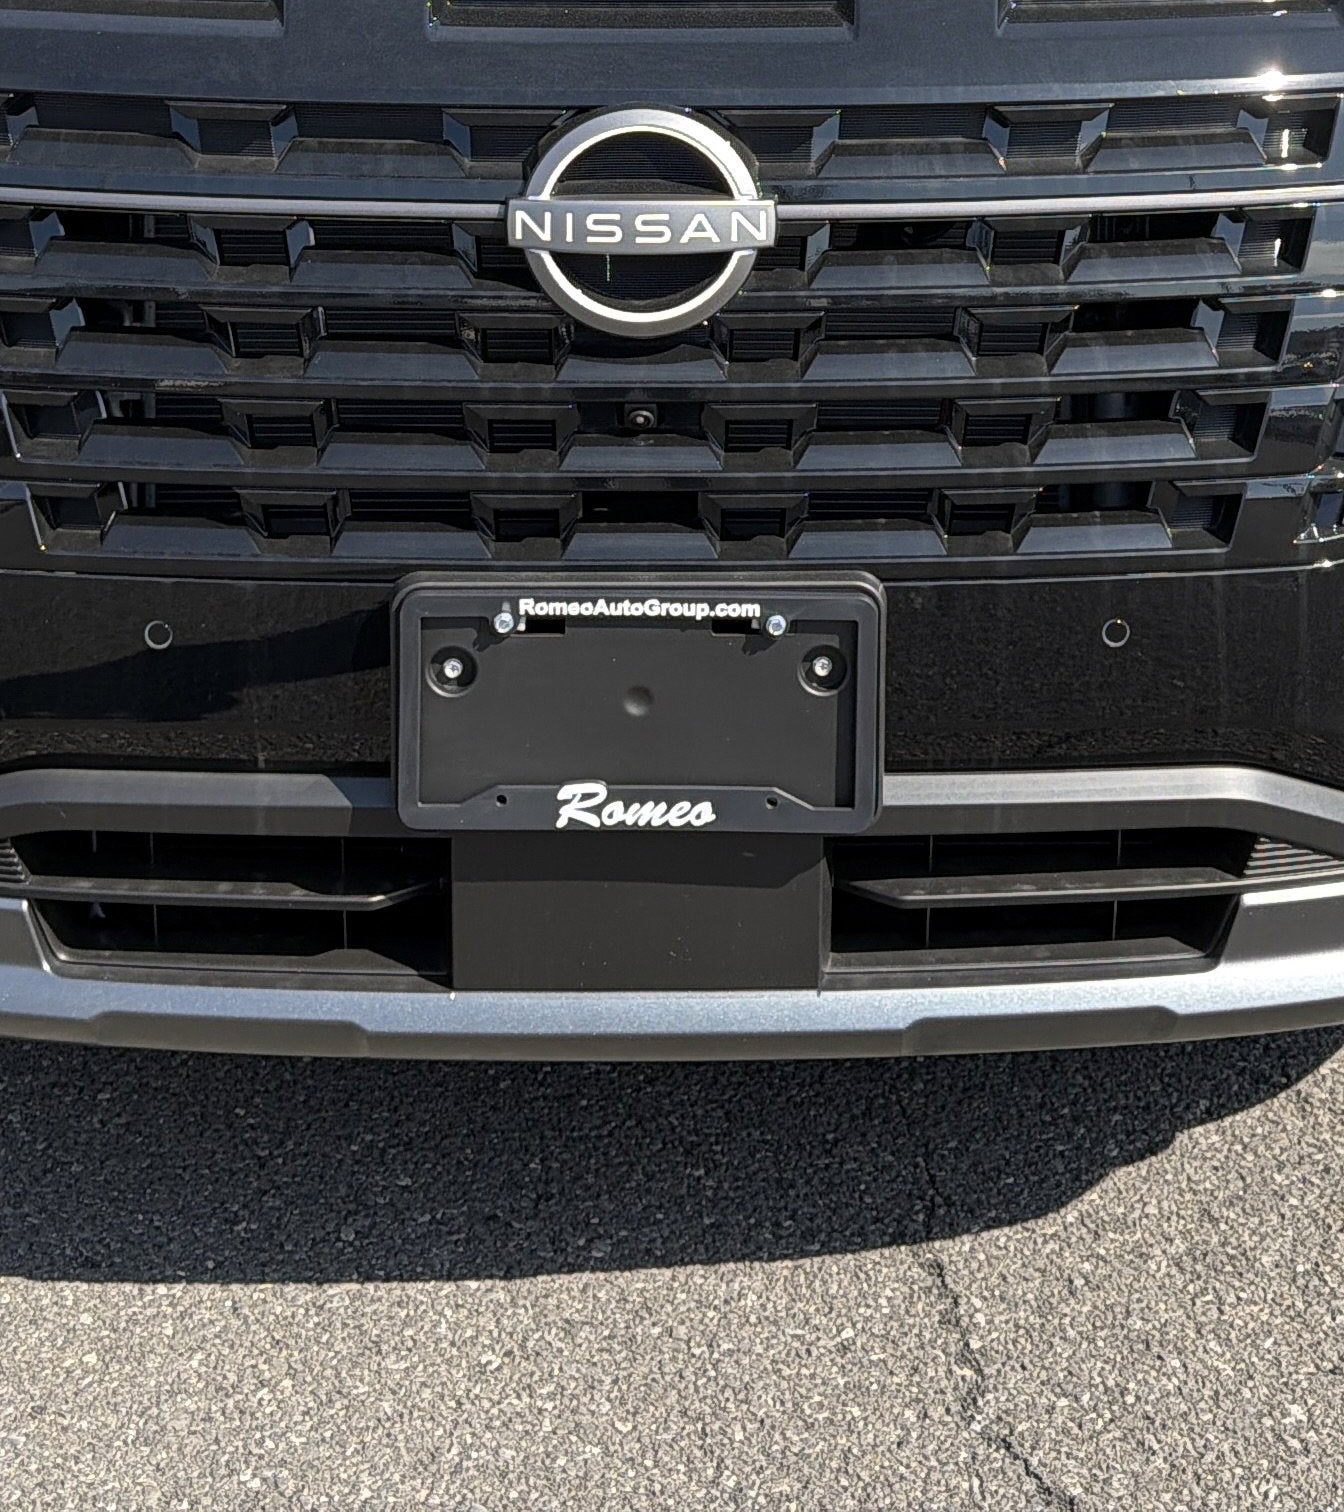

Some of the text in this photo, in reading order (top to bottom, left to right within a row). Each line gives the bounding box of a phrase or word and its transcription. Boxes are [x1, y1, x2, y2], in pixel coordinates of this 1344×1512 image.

[515, 210, 767, 244] NISSAN
[518, 597, 761, 621] RomeoAutoGroup.com
[555, 780, 717, 829] Romeo
